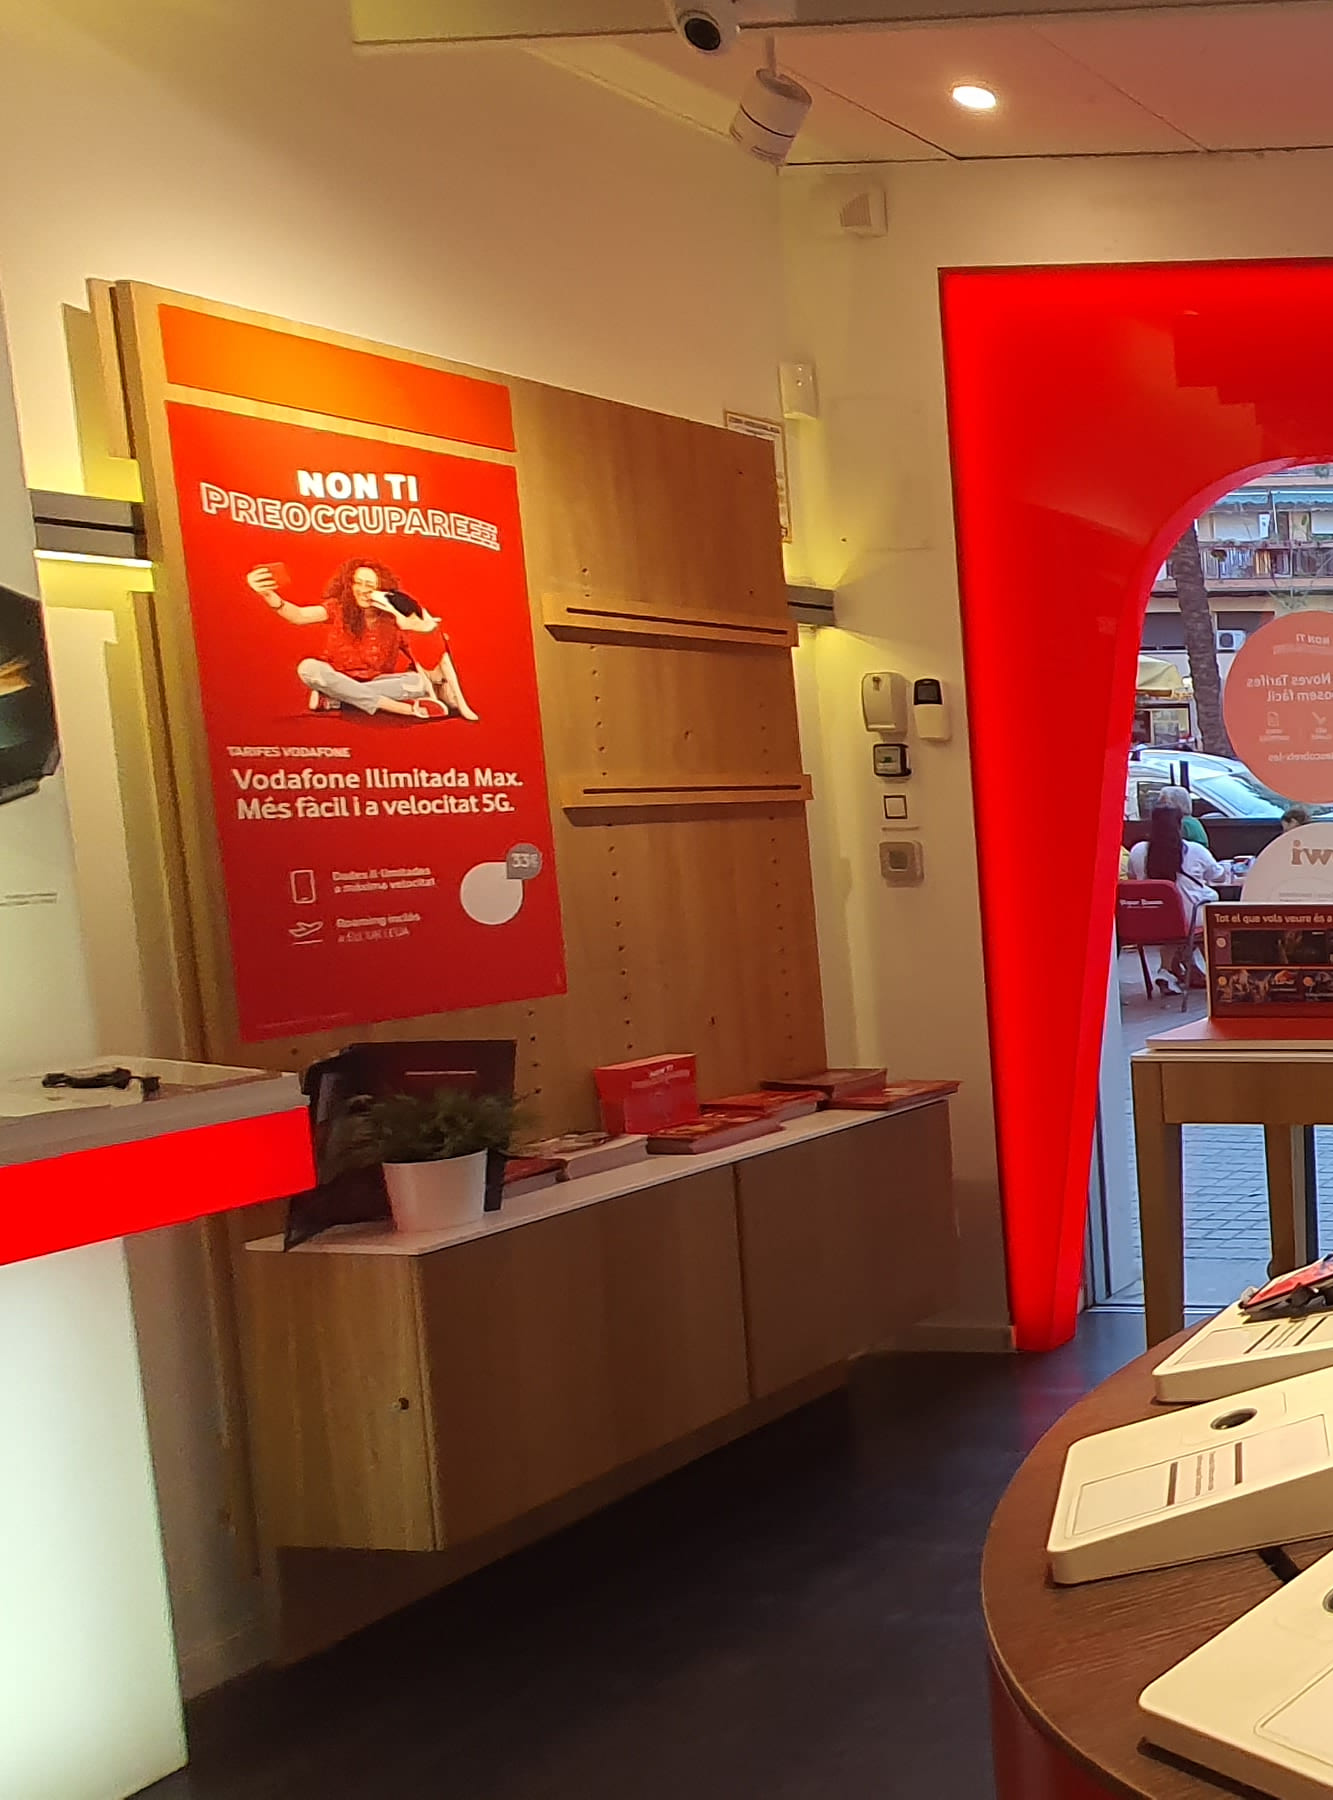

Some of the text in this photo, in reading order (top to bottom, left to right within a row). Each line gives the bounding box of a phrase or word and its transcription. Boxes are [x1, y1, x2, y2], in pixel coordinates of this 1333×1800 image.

[297, 470, 419, 501] NON TI
[232, 768, 361, 791] Vodafone
[474, 768, 523, 788] Max.
[237, 792, 515, 820] Més fàcil i a velocitat 5G.
[1214, 913, 1230, 923] Tot
[1243, 915, 1261, 925] que
